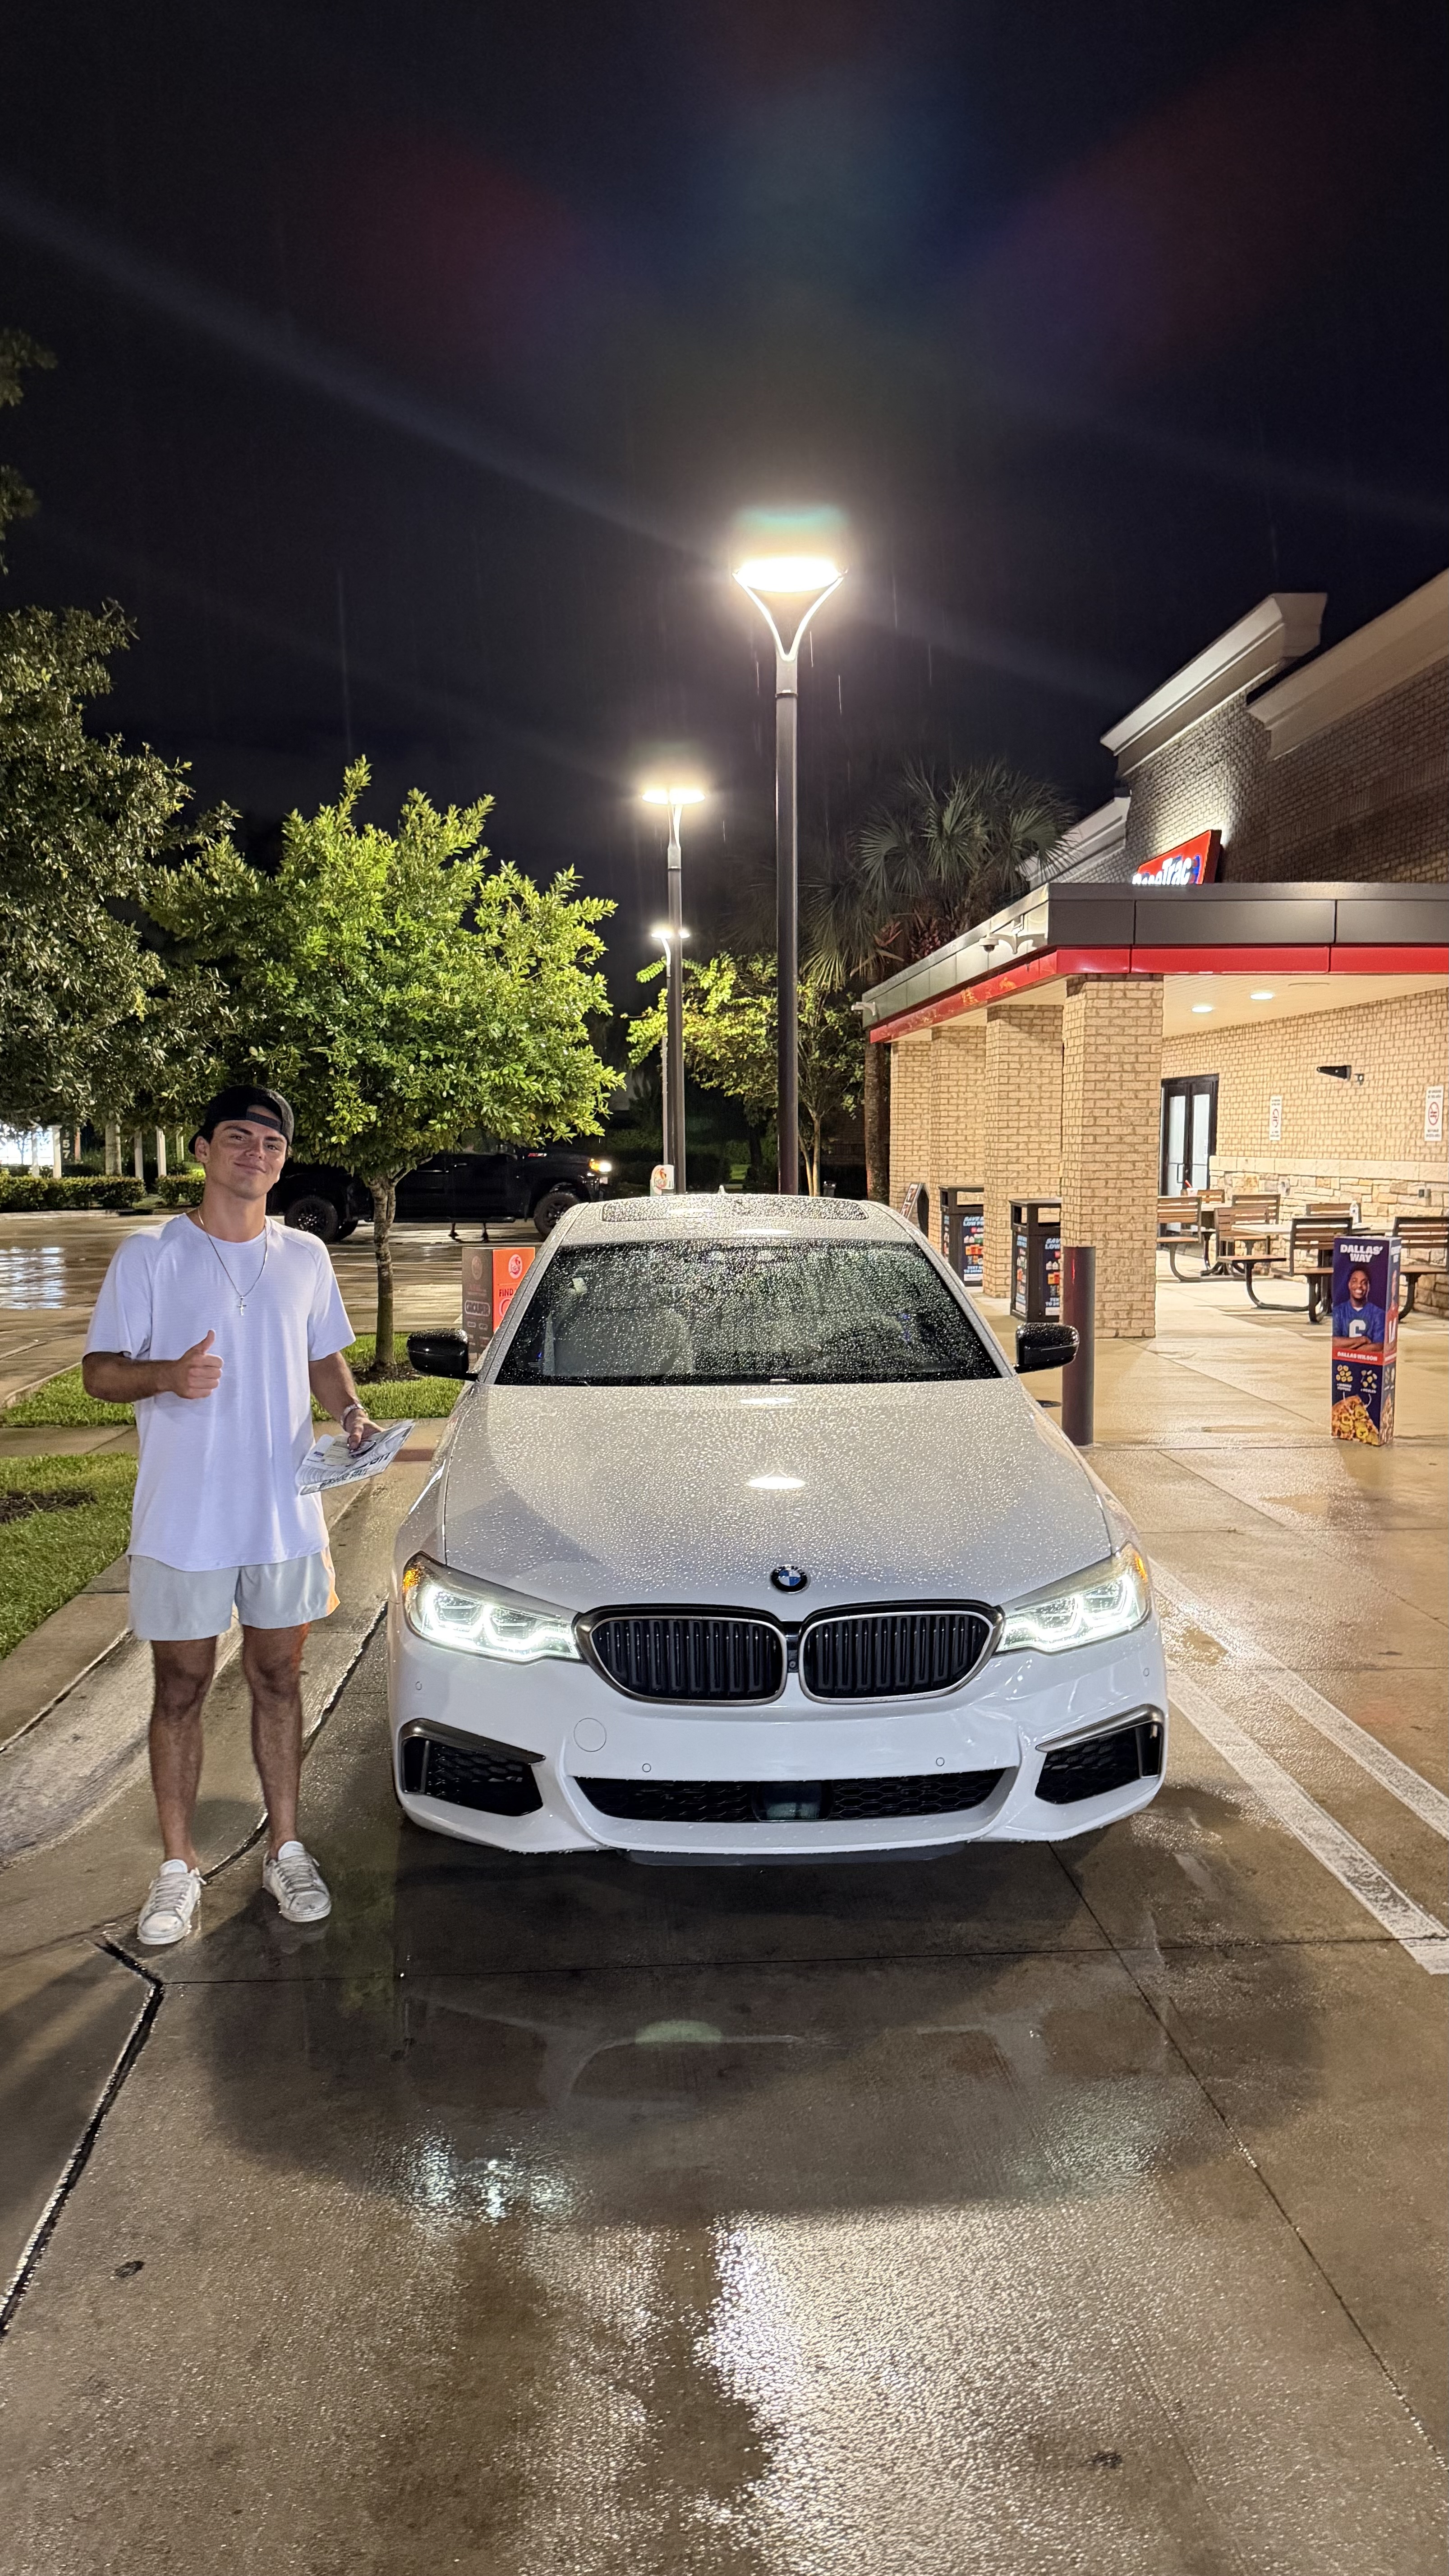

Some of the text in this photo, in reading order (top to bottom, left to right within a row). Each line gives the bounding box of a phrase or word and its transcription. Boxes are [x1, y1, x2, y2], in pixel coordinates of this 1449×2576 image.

[1340, 1244, 1383, 1255] DALLAS'
[1350, 1253, 1372, 1263] WAY
[499, 1288, 514, 1297] FIND
